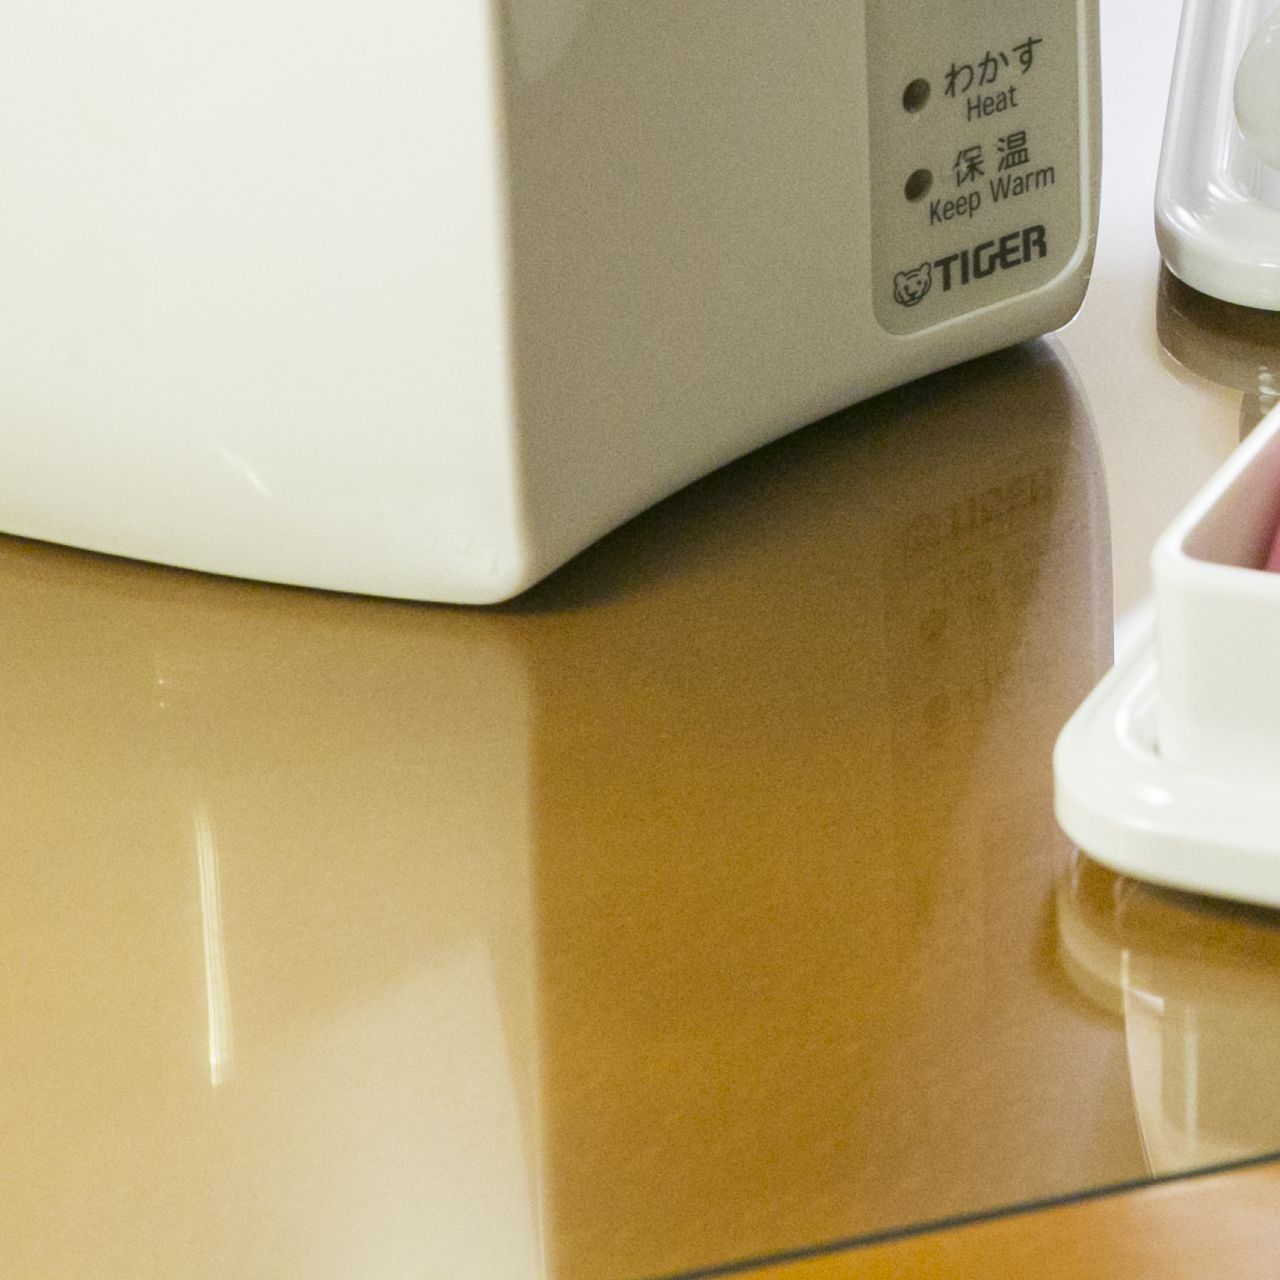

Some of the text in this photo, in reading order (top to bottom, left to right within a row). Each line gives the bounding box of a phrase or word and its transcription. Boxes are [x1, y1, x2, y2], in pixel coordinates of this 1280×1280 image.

[943, 36, 1043, 98] わかす
[966, 85, 1018, 122] Heat
[953, 130, 1030, 187] 保温
[929, 166, 1056, 226] Keep Warm
[933, 224, 1048, 292] TIGER
